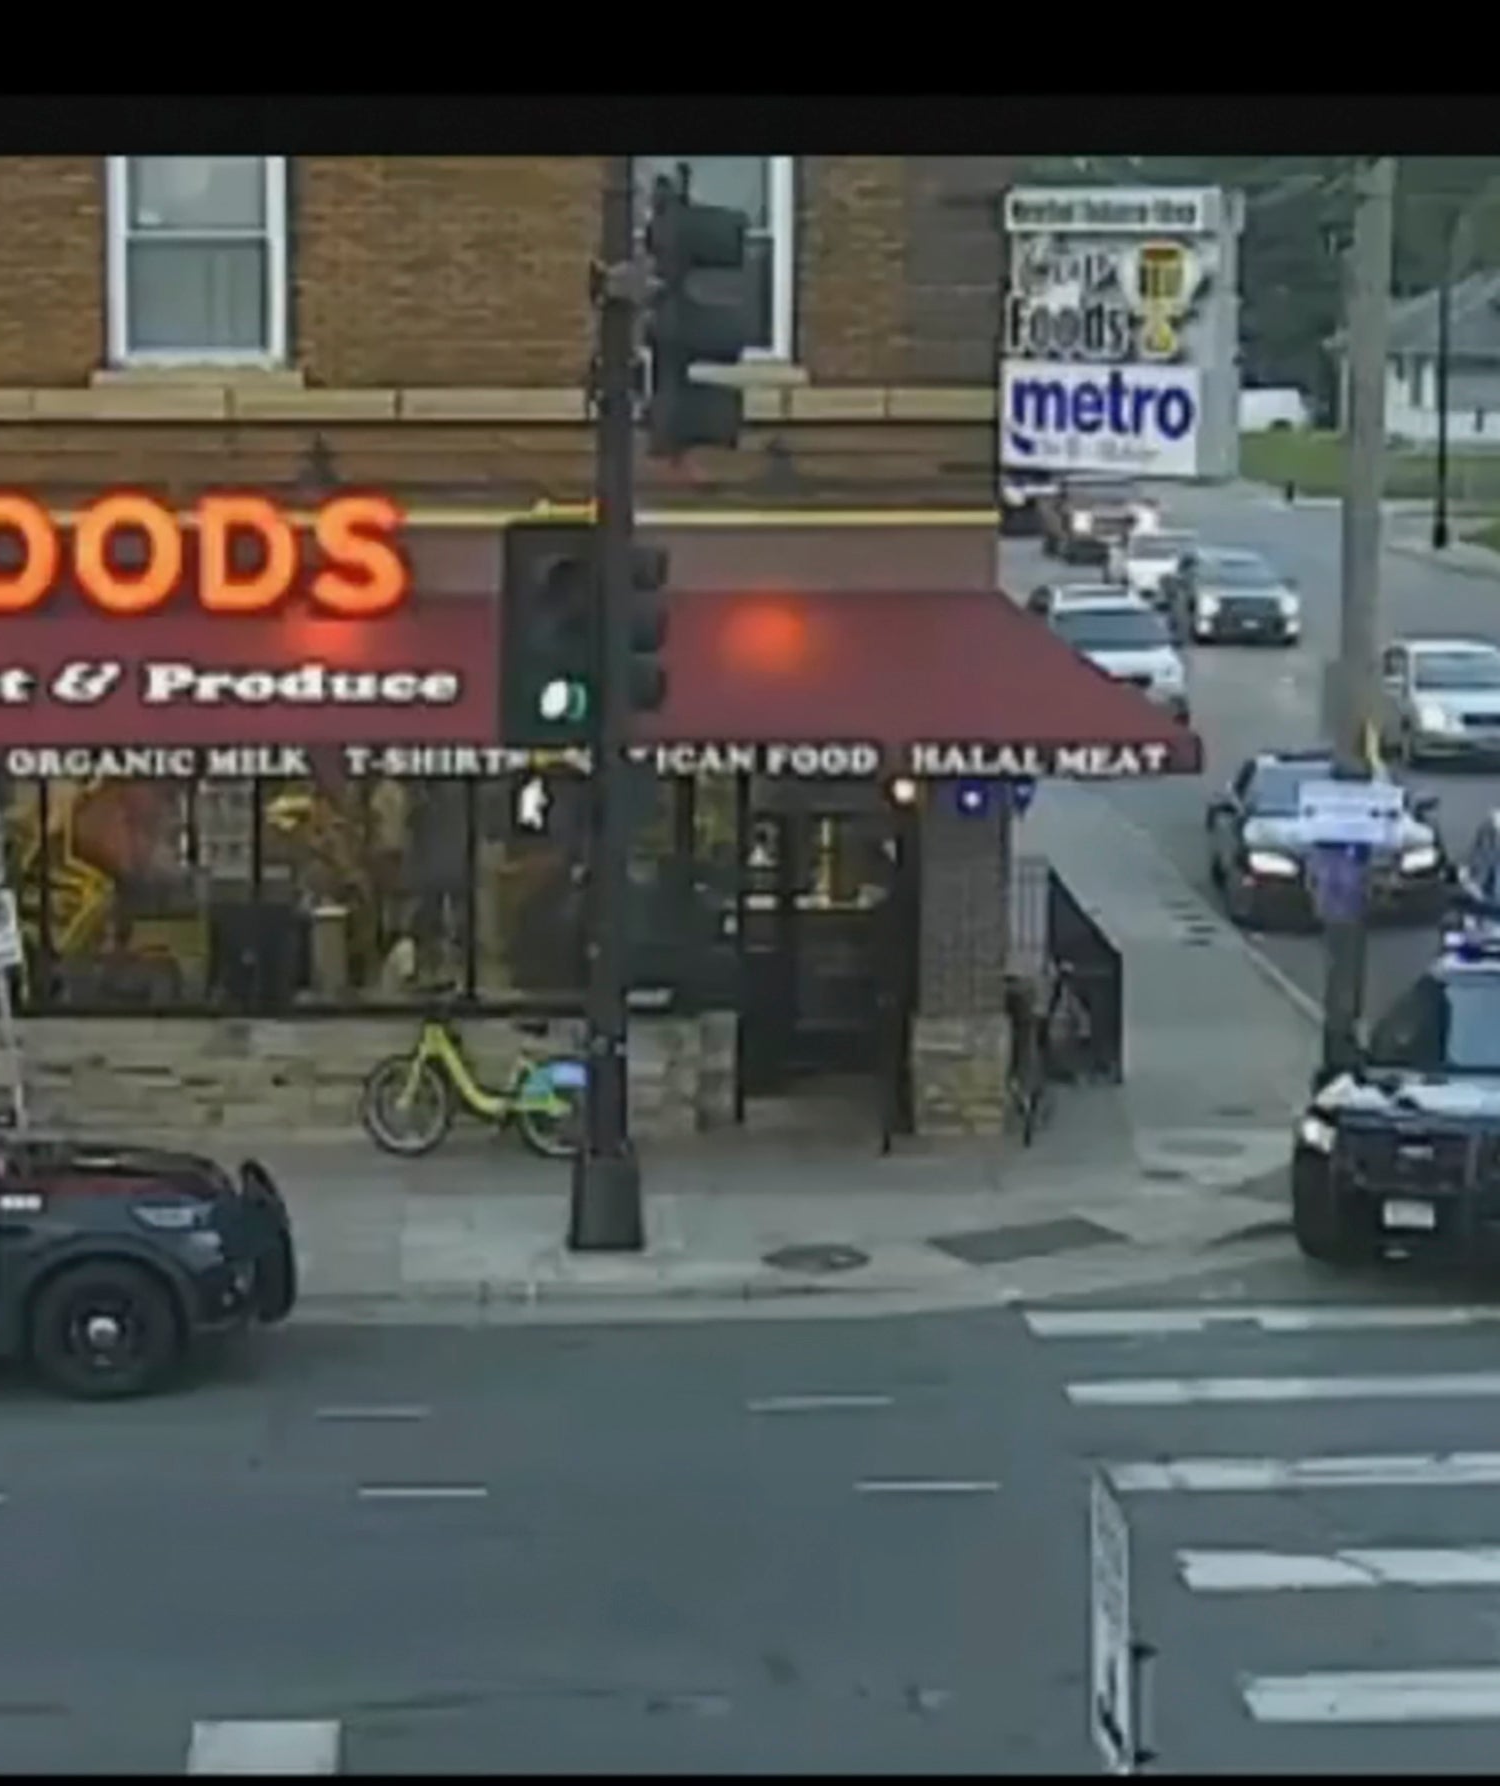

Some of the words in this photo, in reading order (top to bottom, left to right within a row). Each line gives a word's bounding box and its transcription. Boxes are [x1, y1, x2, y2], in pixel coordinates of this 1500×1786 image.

[1012, 371, 1195, 442] metro
[53, 662, 121, 701] &
[145, 664, 460, 702] Produce
[7, 748, 195, 775] ORGANIC
[209, 747, 309, 775] MILK
[767, 746, 878, 774] FOOD
[912, 745, 1045, 775] HALAL
[1056, 745, 1167, 775] MEAT
